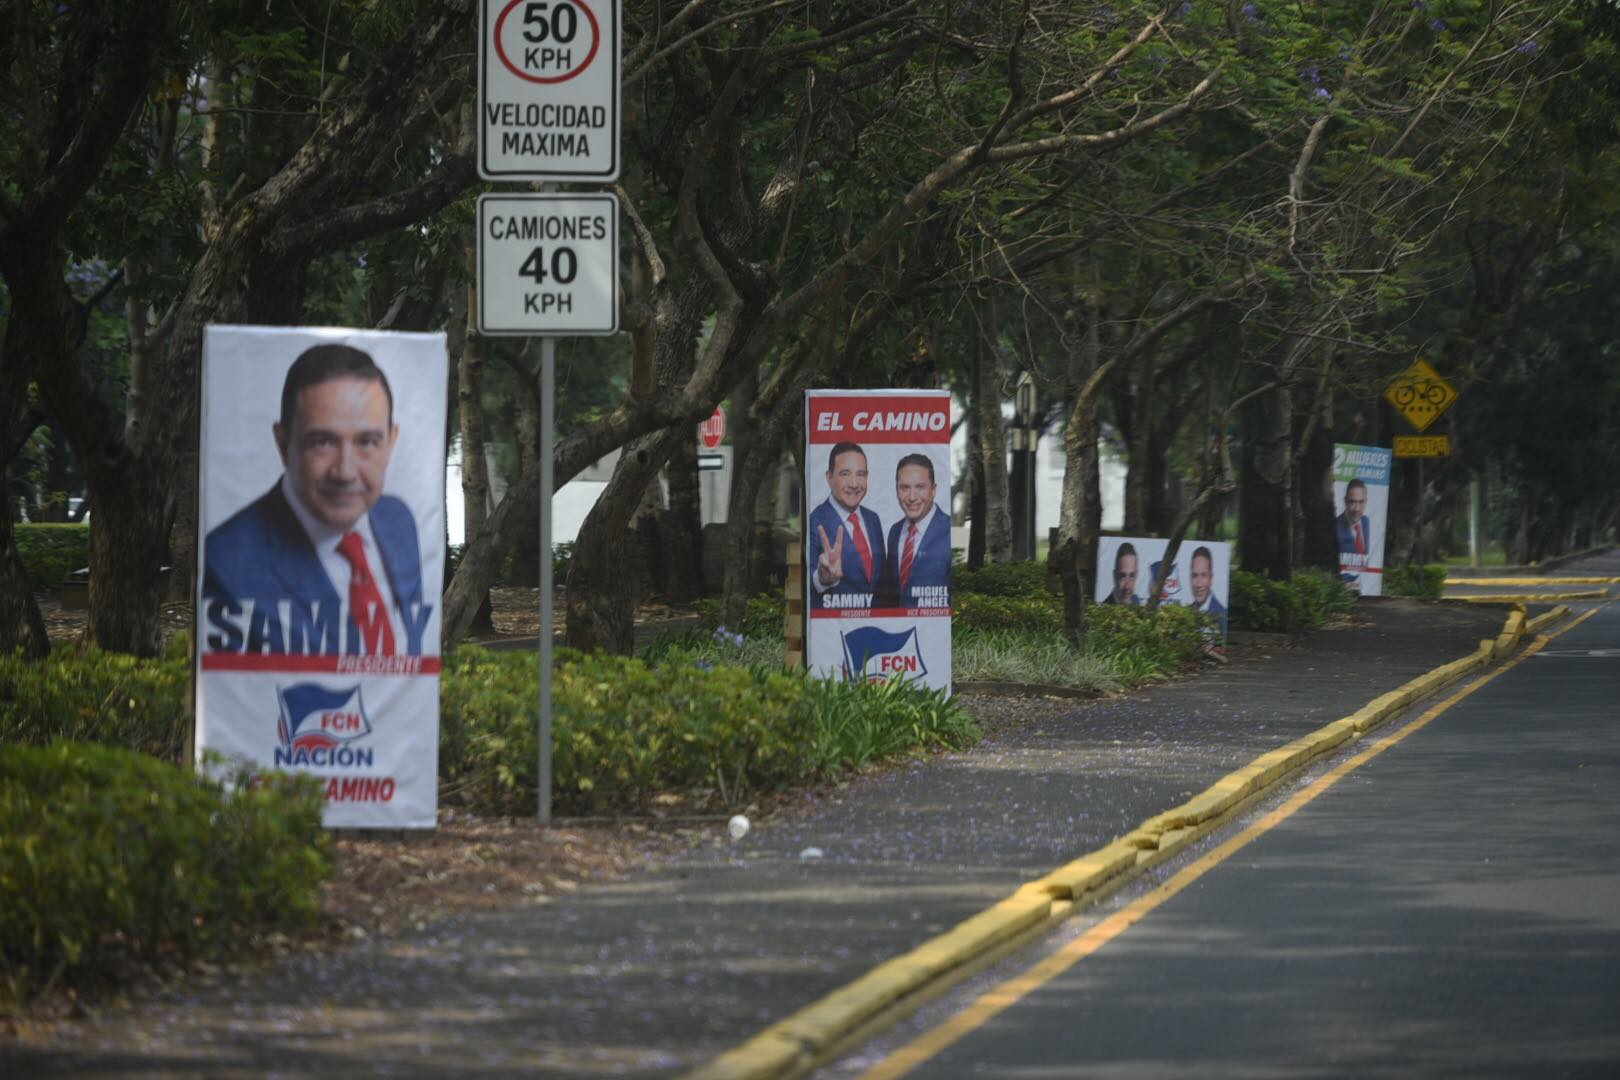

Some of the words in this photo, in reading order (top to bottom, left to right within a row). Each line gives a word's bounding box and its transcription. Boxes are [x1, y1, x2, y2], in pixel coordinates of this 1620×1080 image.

[522, 3, 577, 43] 50
[525, 48, 571, 69] KPH
[487, 103, 606, 128] VELOCIDAD
[502, 132, 590, 157] MAXIMA
[489, 216, 606, 240] CAMIONES
[518, 246, 577, 285] 40
[524, 293, 572, 314] KPH
[817, 412, 844, 431] EL
[852, 411, 946, 431] CAMINO
[823, 593, 873, 608] SAMMY
[911, 586, 949, 597] MIGUEL
[917, 597, 949, 608] ANGEL
[206, 598, 433, 656] SAMMY
[337, 655, 422, 675] PRESIDENTE
[881, 655, 917, 672] FCN
[321, 712, 360, 731] FCN
[274, 743, 373, 767] NACIÓN
[323, 775, 396, 803] AMINO
